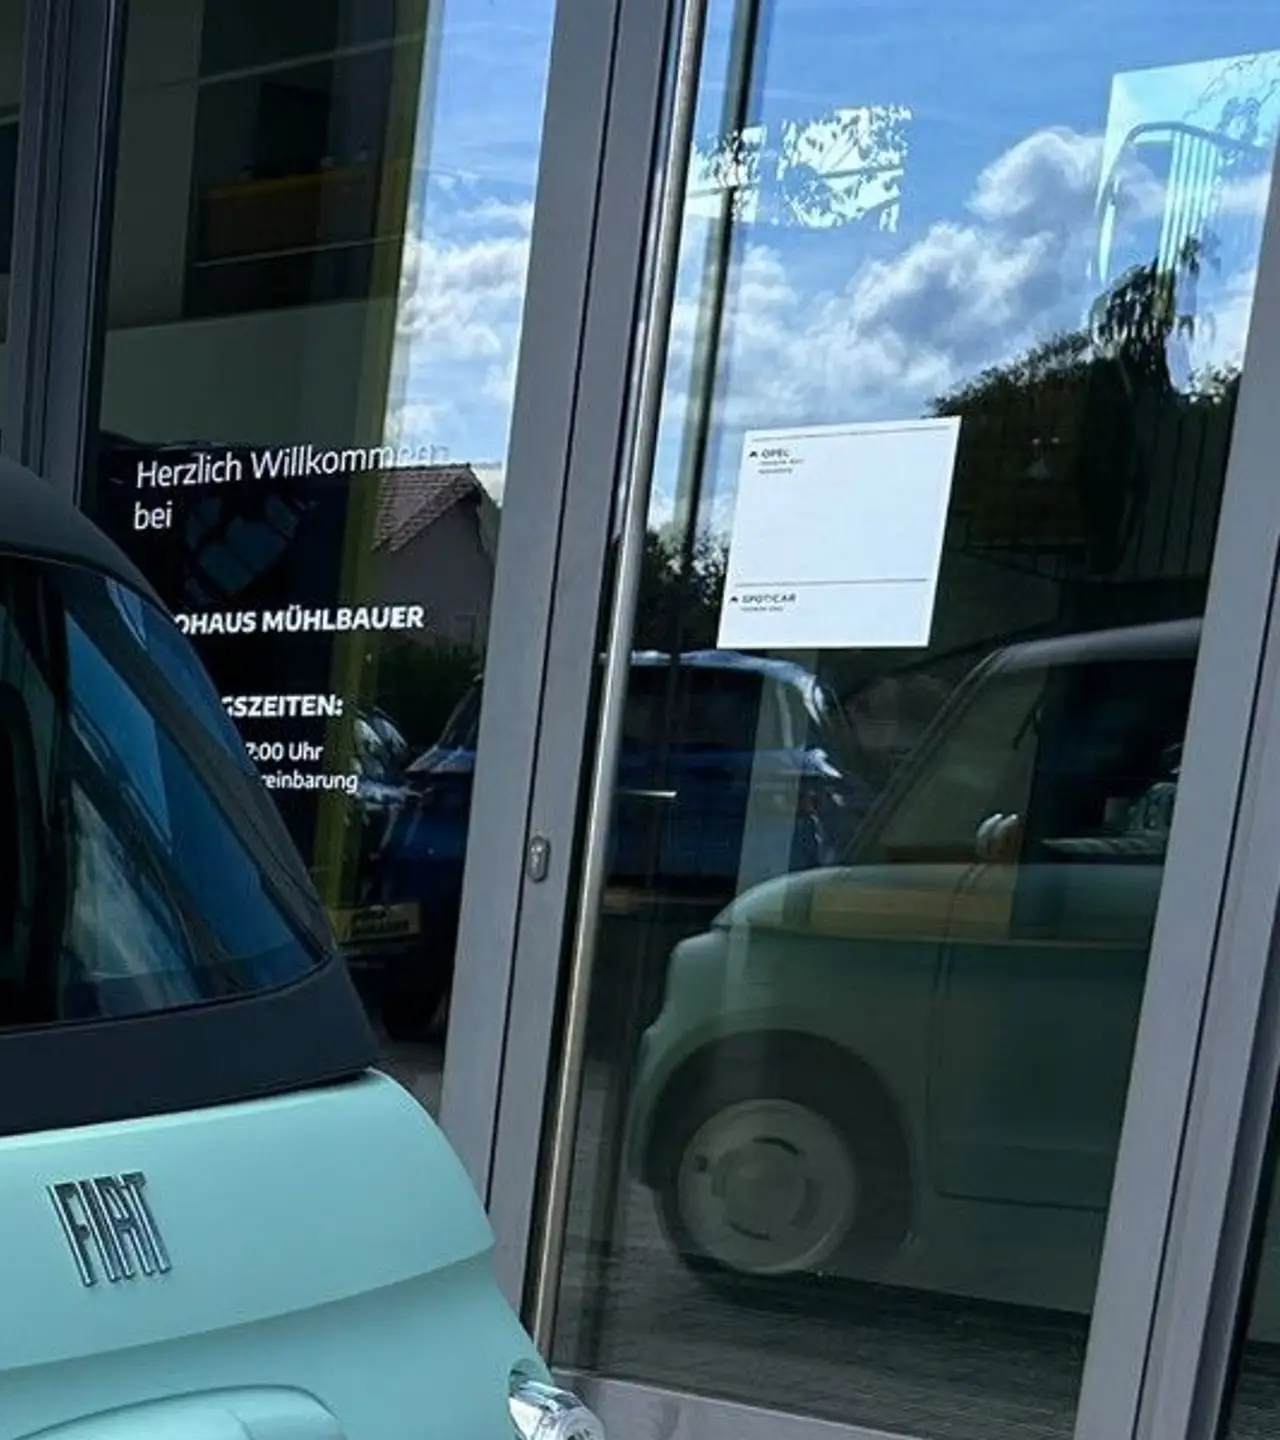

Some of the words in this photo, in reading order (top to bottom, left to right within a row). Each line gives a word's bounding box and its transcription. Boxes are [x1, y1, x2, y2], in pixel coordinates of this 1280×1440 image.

[137, 452, 241, 488] Herzlich
[134, 501, 172, 530] bei
[262, 605, 424, 633] MÜHLBAUER
[288, 742, 324, 760] Uhr
[45, 1170, 172, 1288] FIAT
